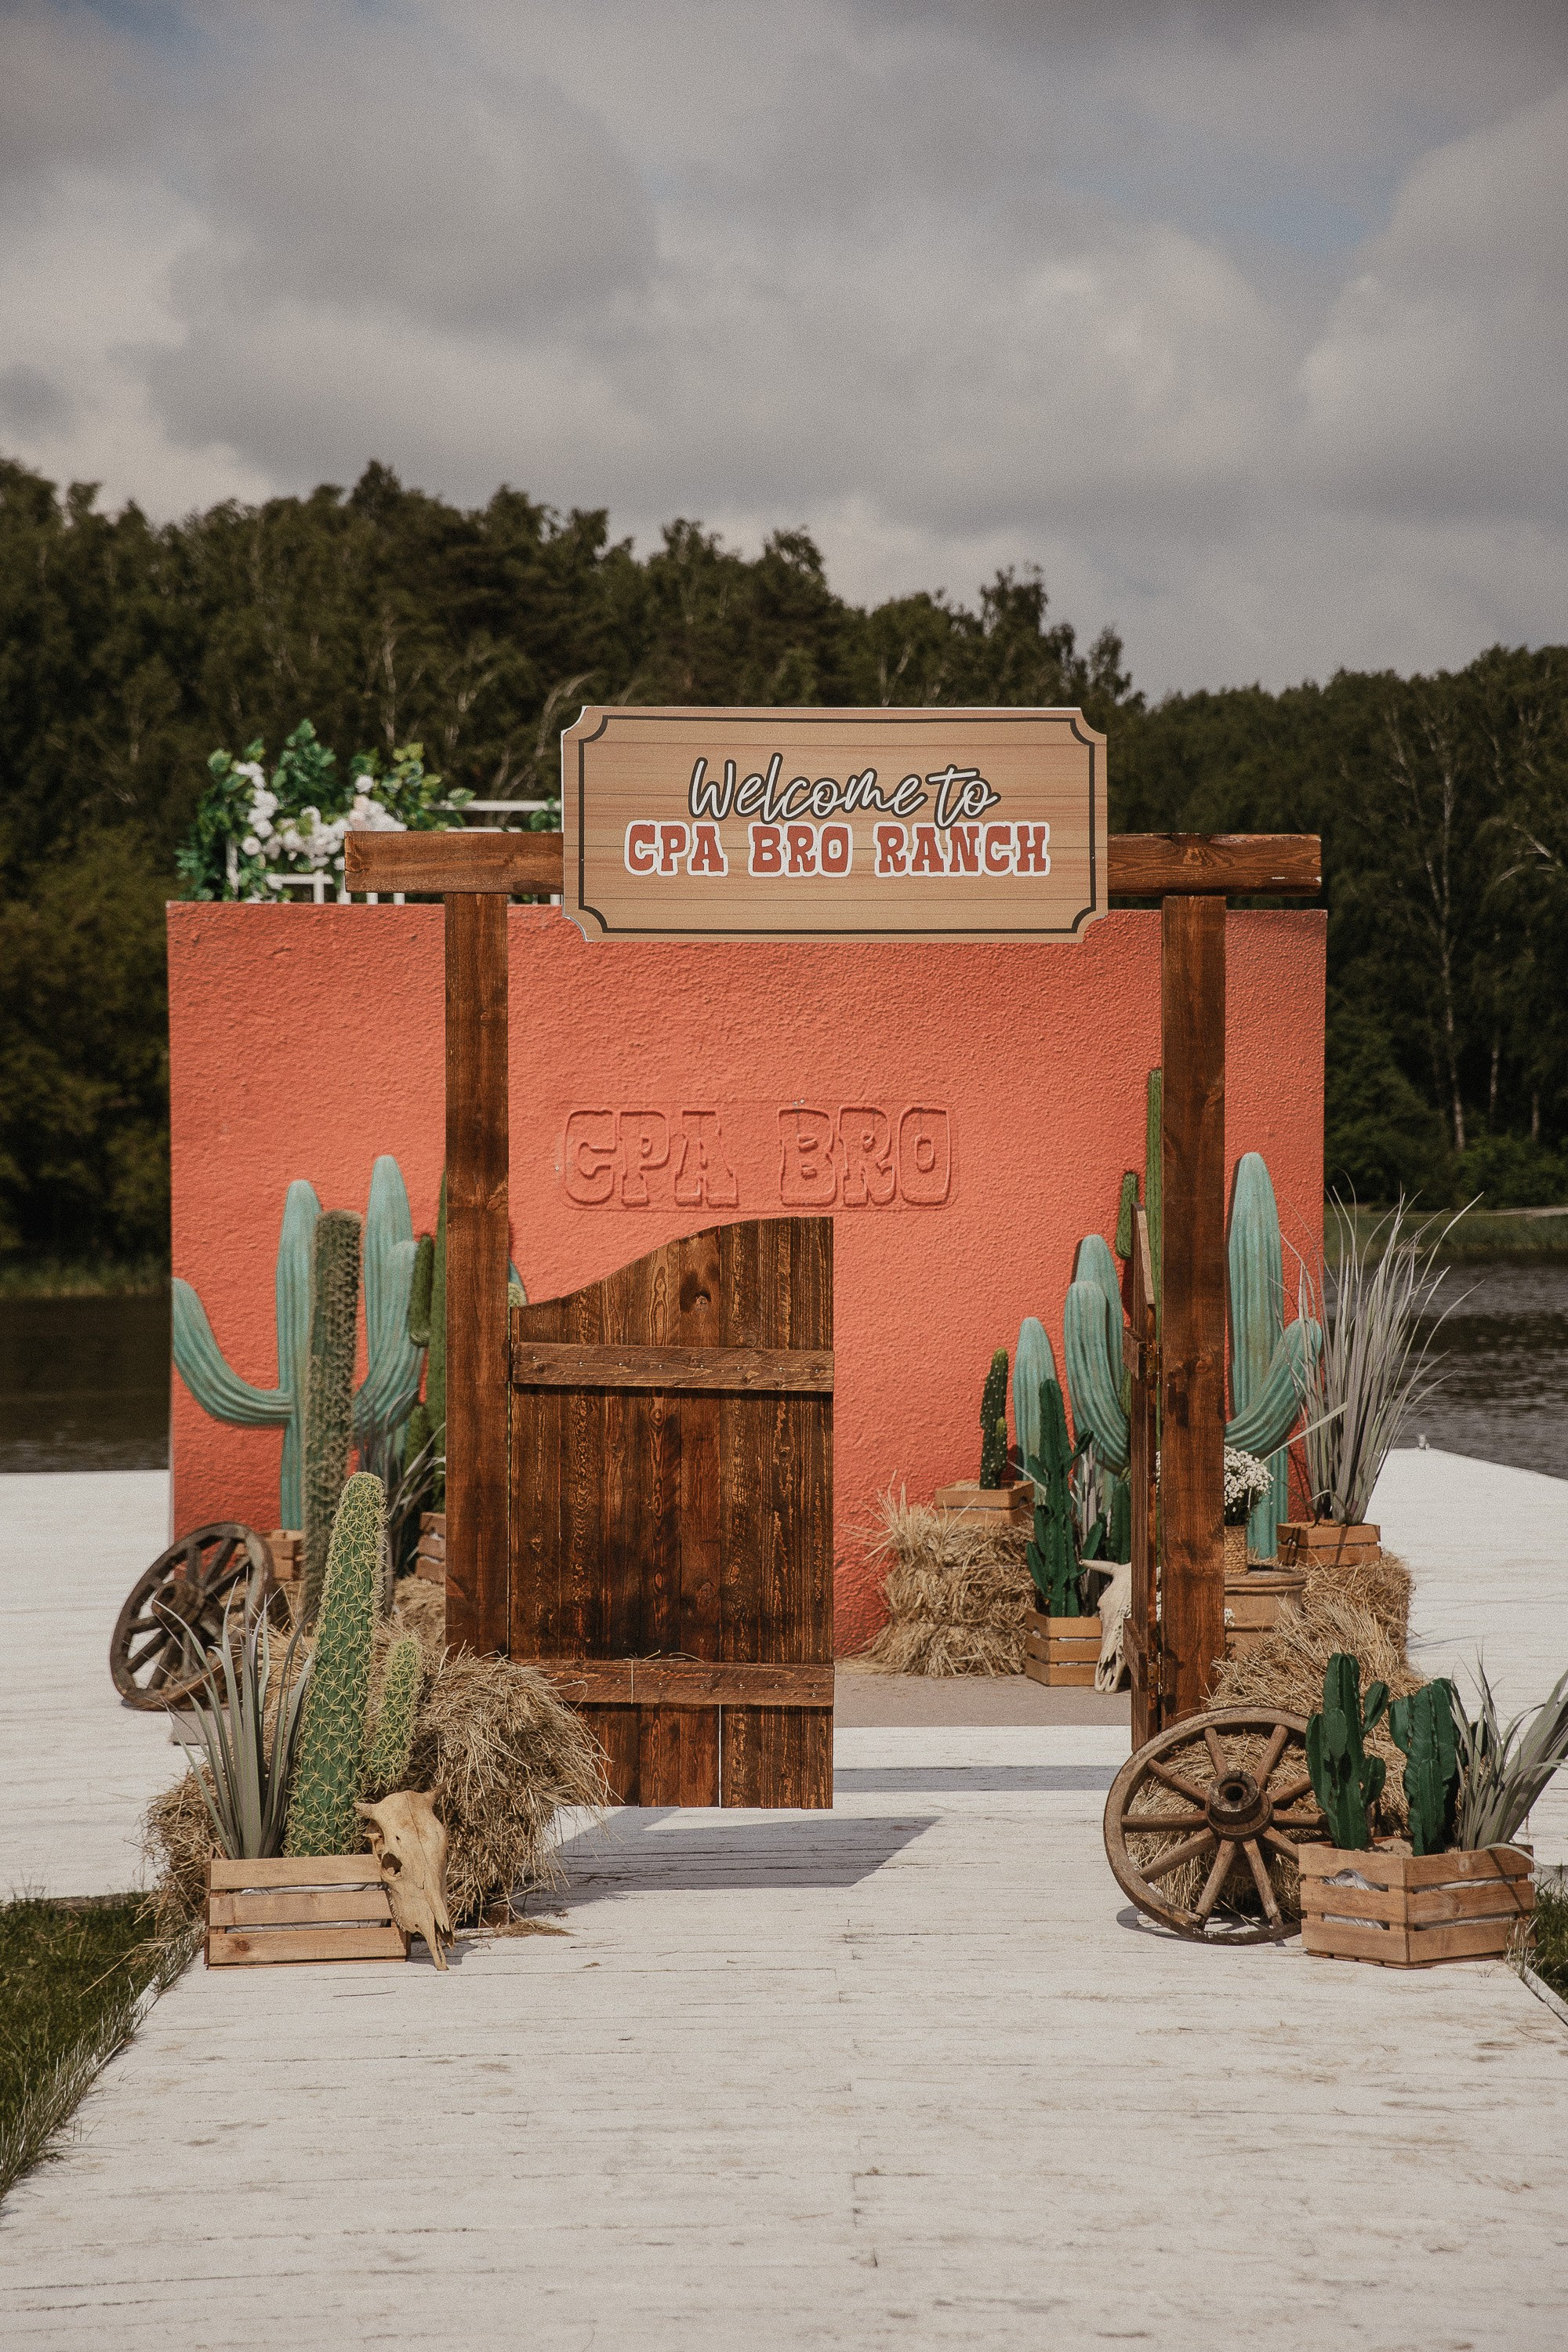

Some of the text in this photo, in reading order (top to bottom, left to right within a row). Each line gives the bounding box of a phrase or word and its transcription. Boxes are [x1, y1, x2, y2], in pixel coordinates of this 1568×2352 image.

[689, 753, 1000, 829] Welcome to
[625, 821, 1051, 878] CPA BRO RANCH
[564, 1105, 951, 1208] CPA BRO
